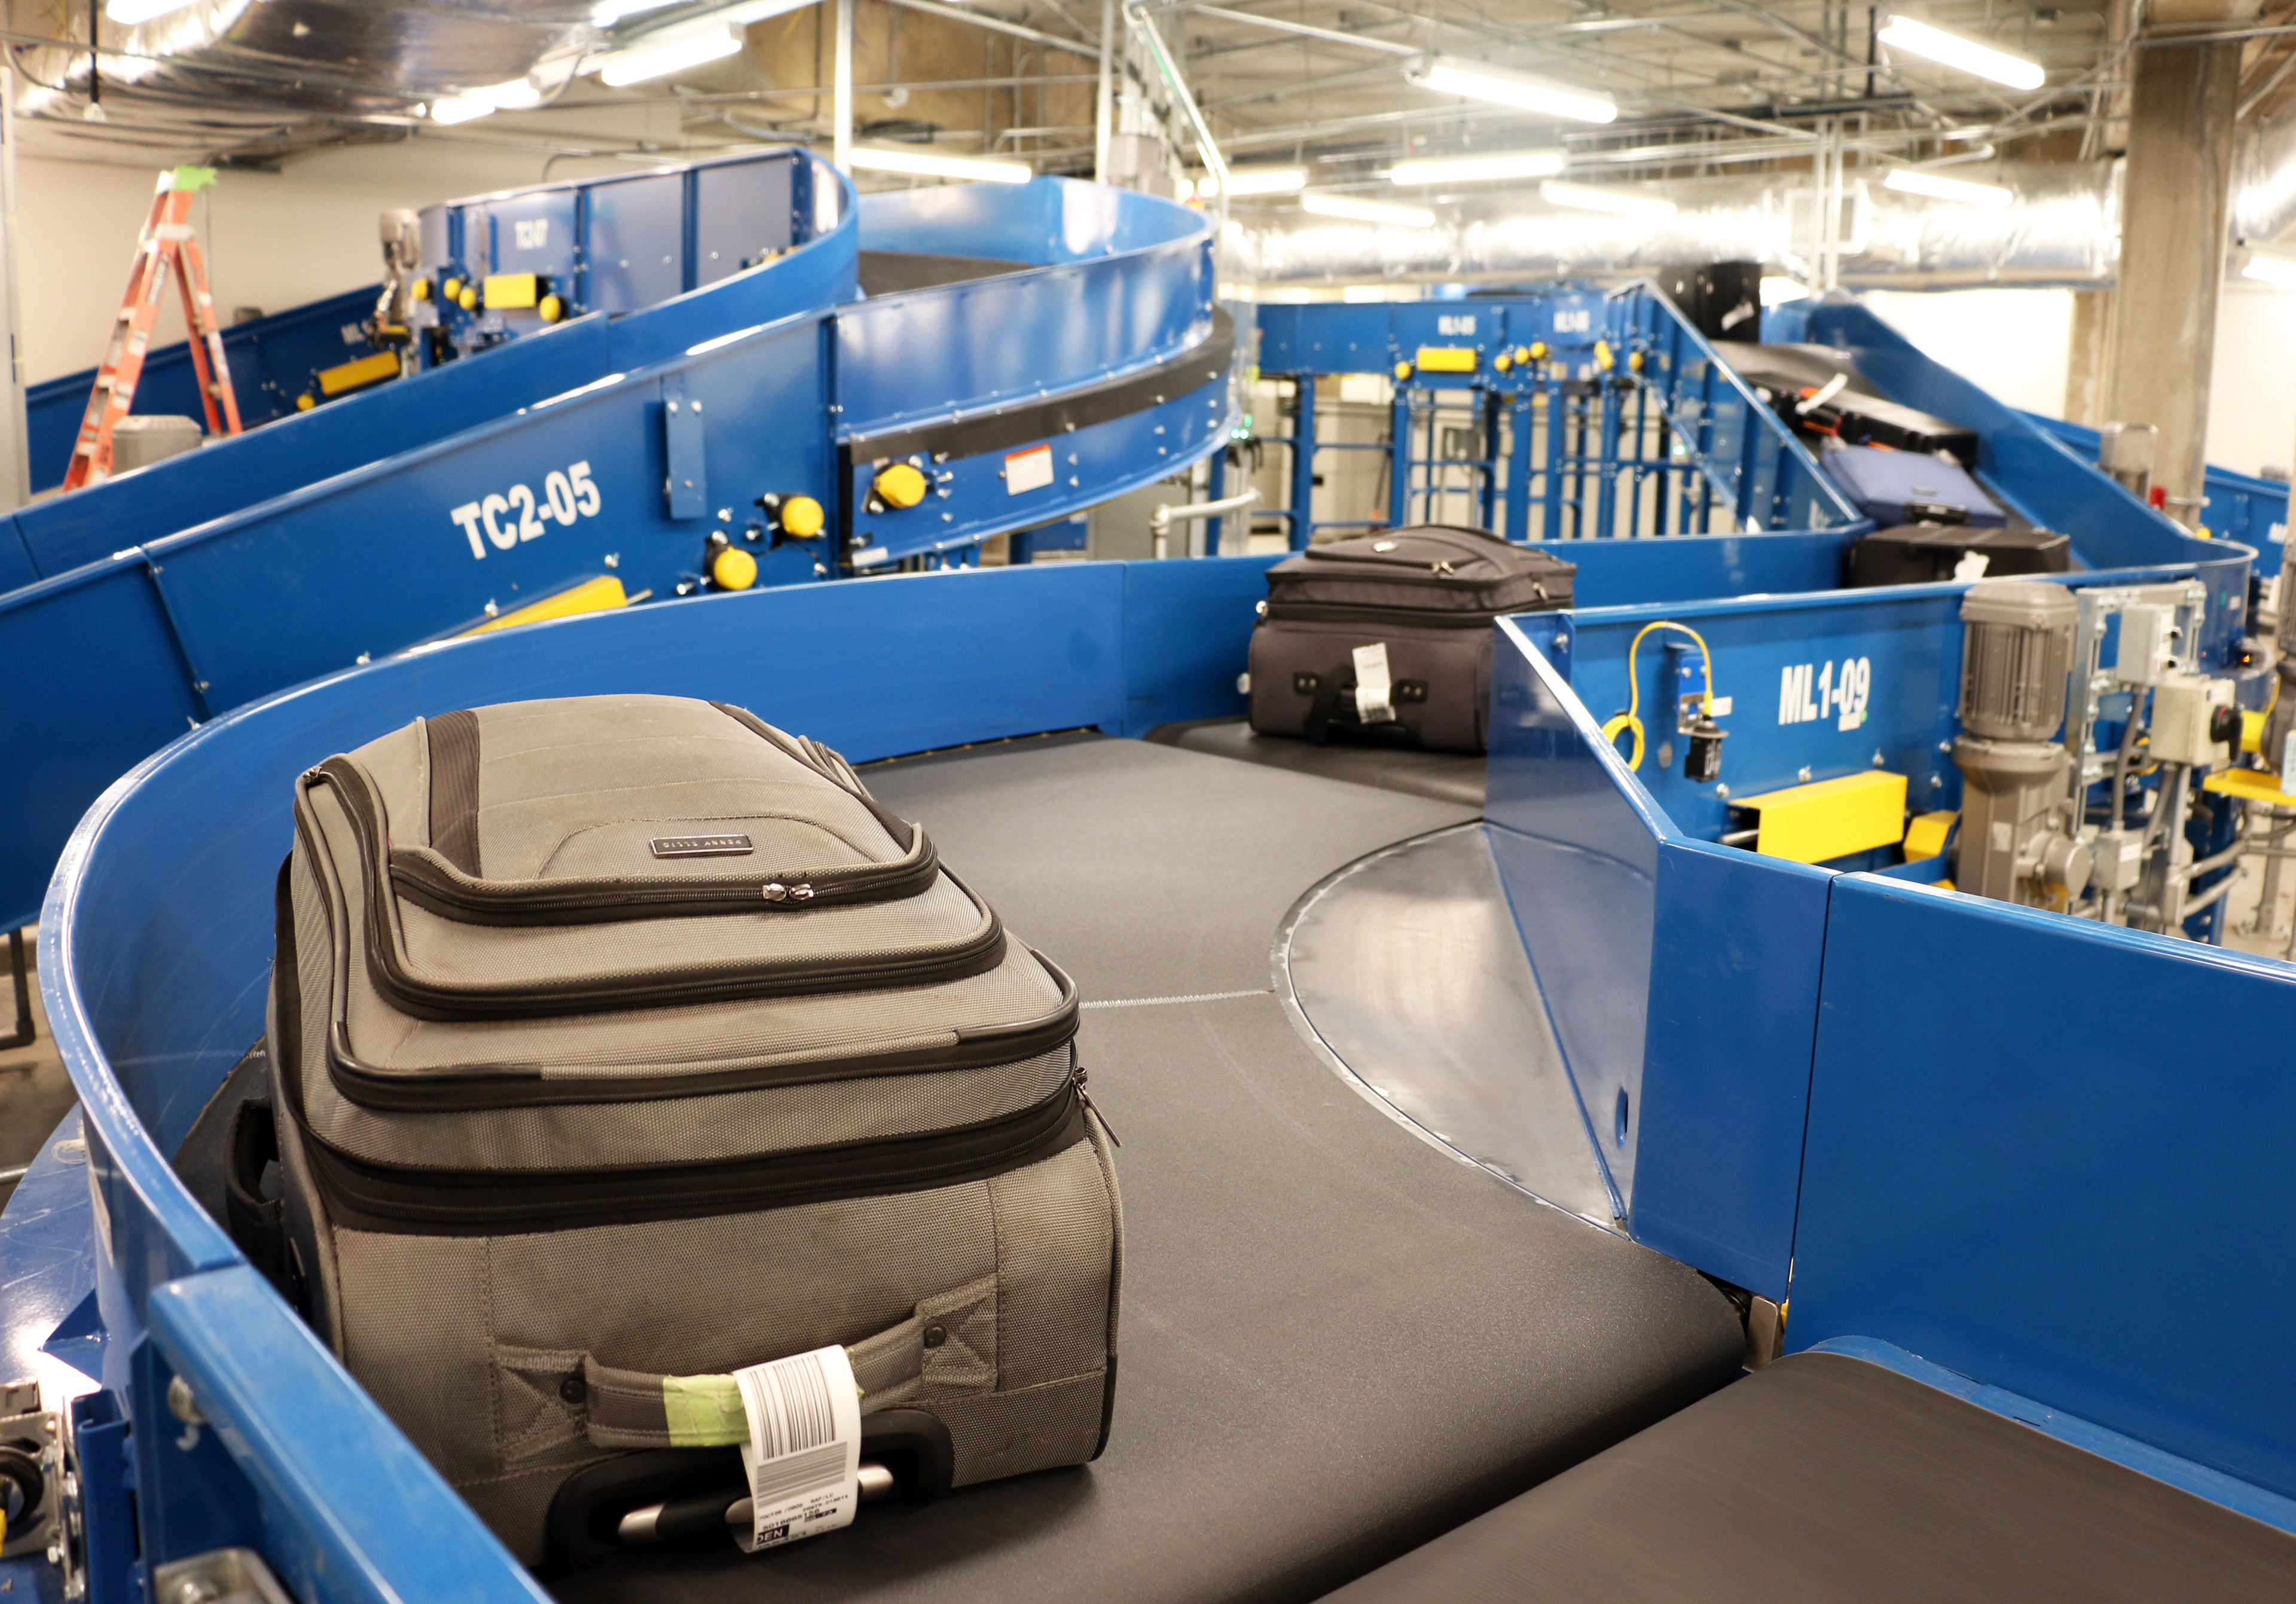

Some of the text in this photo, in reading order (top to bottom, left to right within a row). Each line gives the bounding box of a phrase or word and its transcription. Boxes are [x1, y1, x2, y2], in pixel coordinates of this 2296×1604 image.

[450, 460, 601, 560] TC2-05
[1778, 656, 1871, 725] ML1-09
[756, 1527, 783, 1542] DEN
